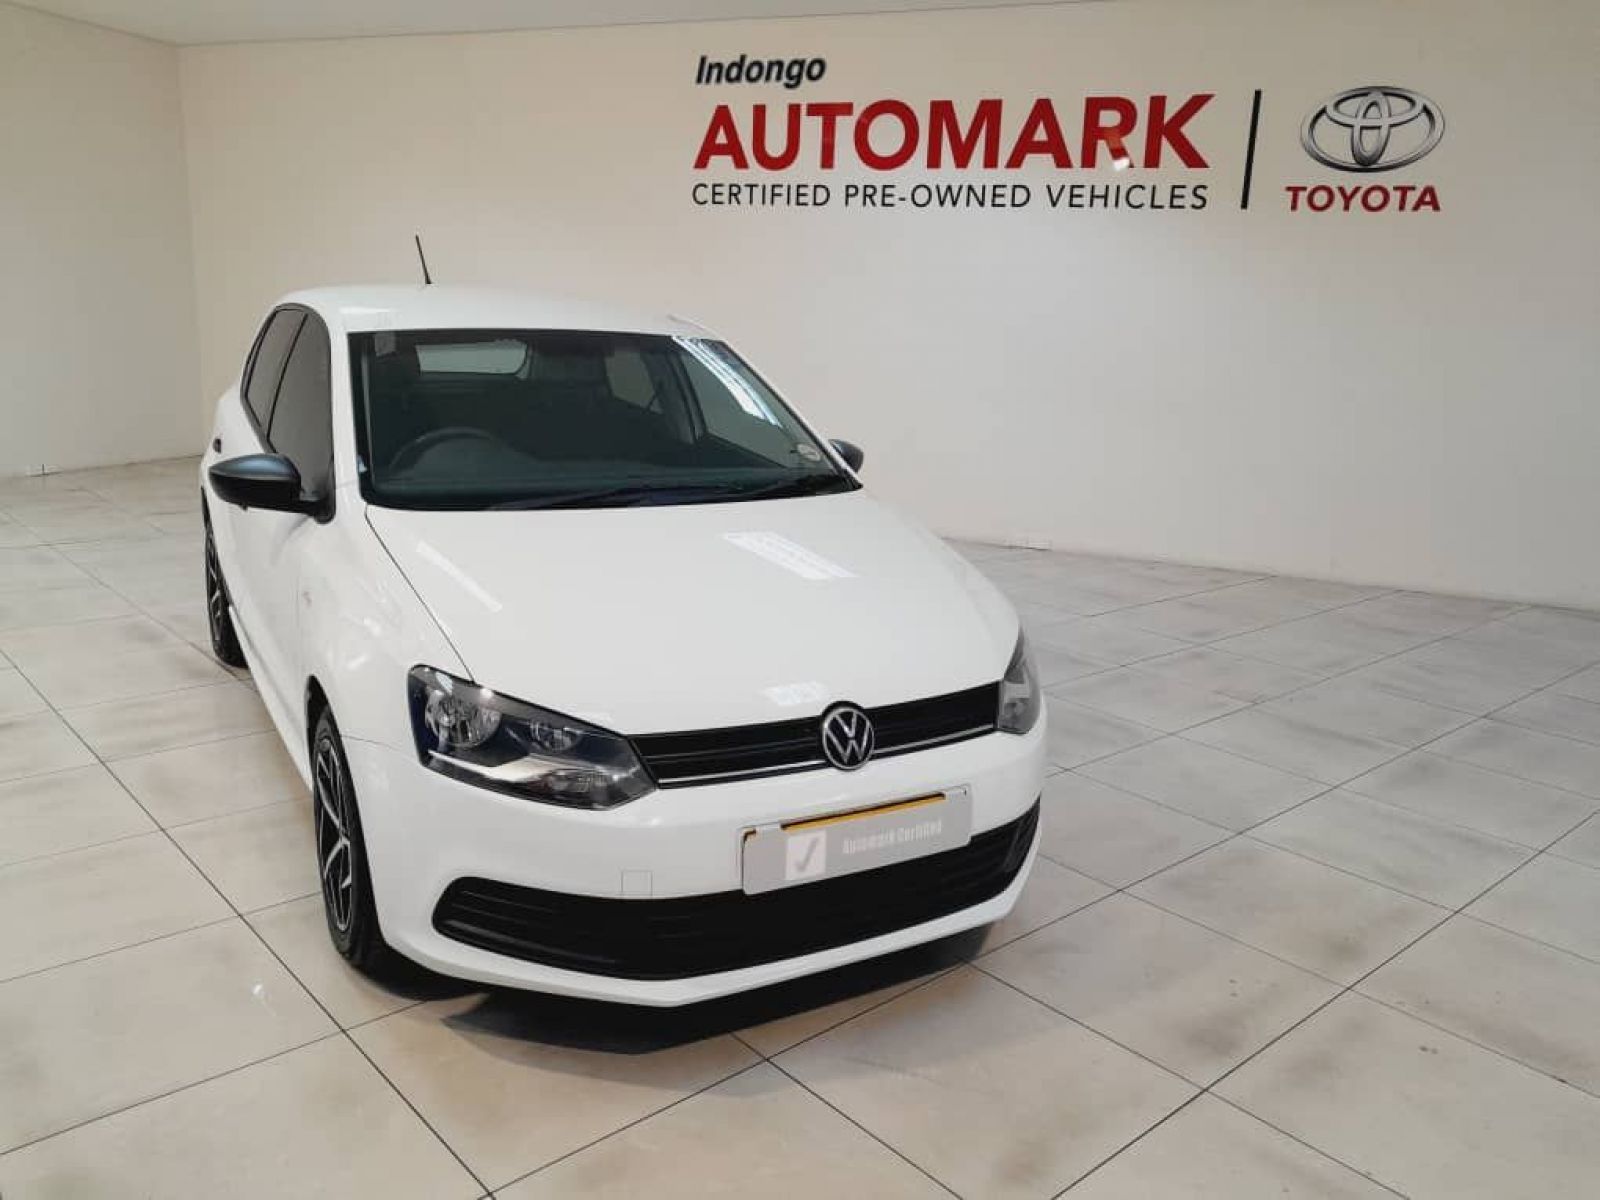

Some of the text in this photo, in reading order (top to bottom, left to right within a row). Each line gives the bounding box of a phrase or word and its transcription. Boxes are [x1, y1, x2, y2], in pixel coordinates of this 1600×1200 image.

[695, 54, 827, 89] Indongo
[693, 94, 1215, 171] AUTOMARK
[692, 183, 1208, 210] CERTIFIED PRE-OWNED VEHICLES
[1286, 185, 1441, 212] TOYOTA
